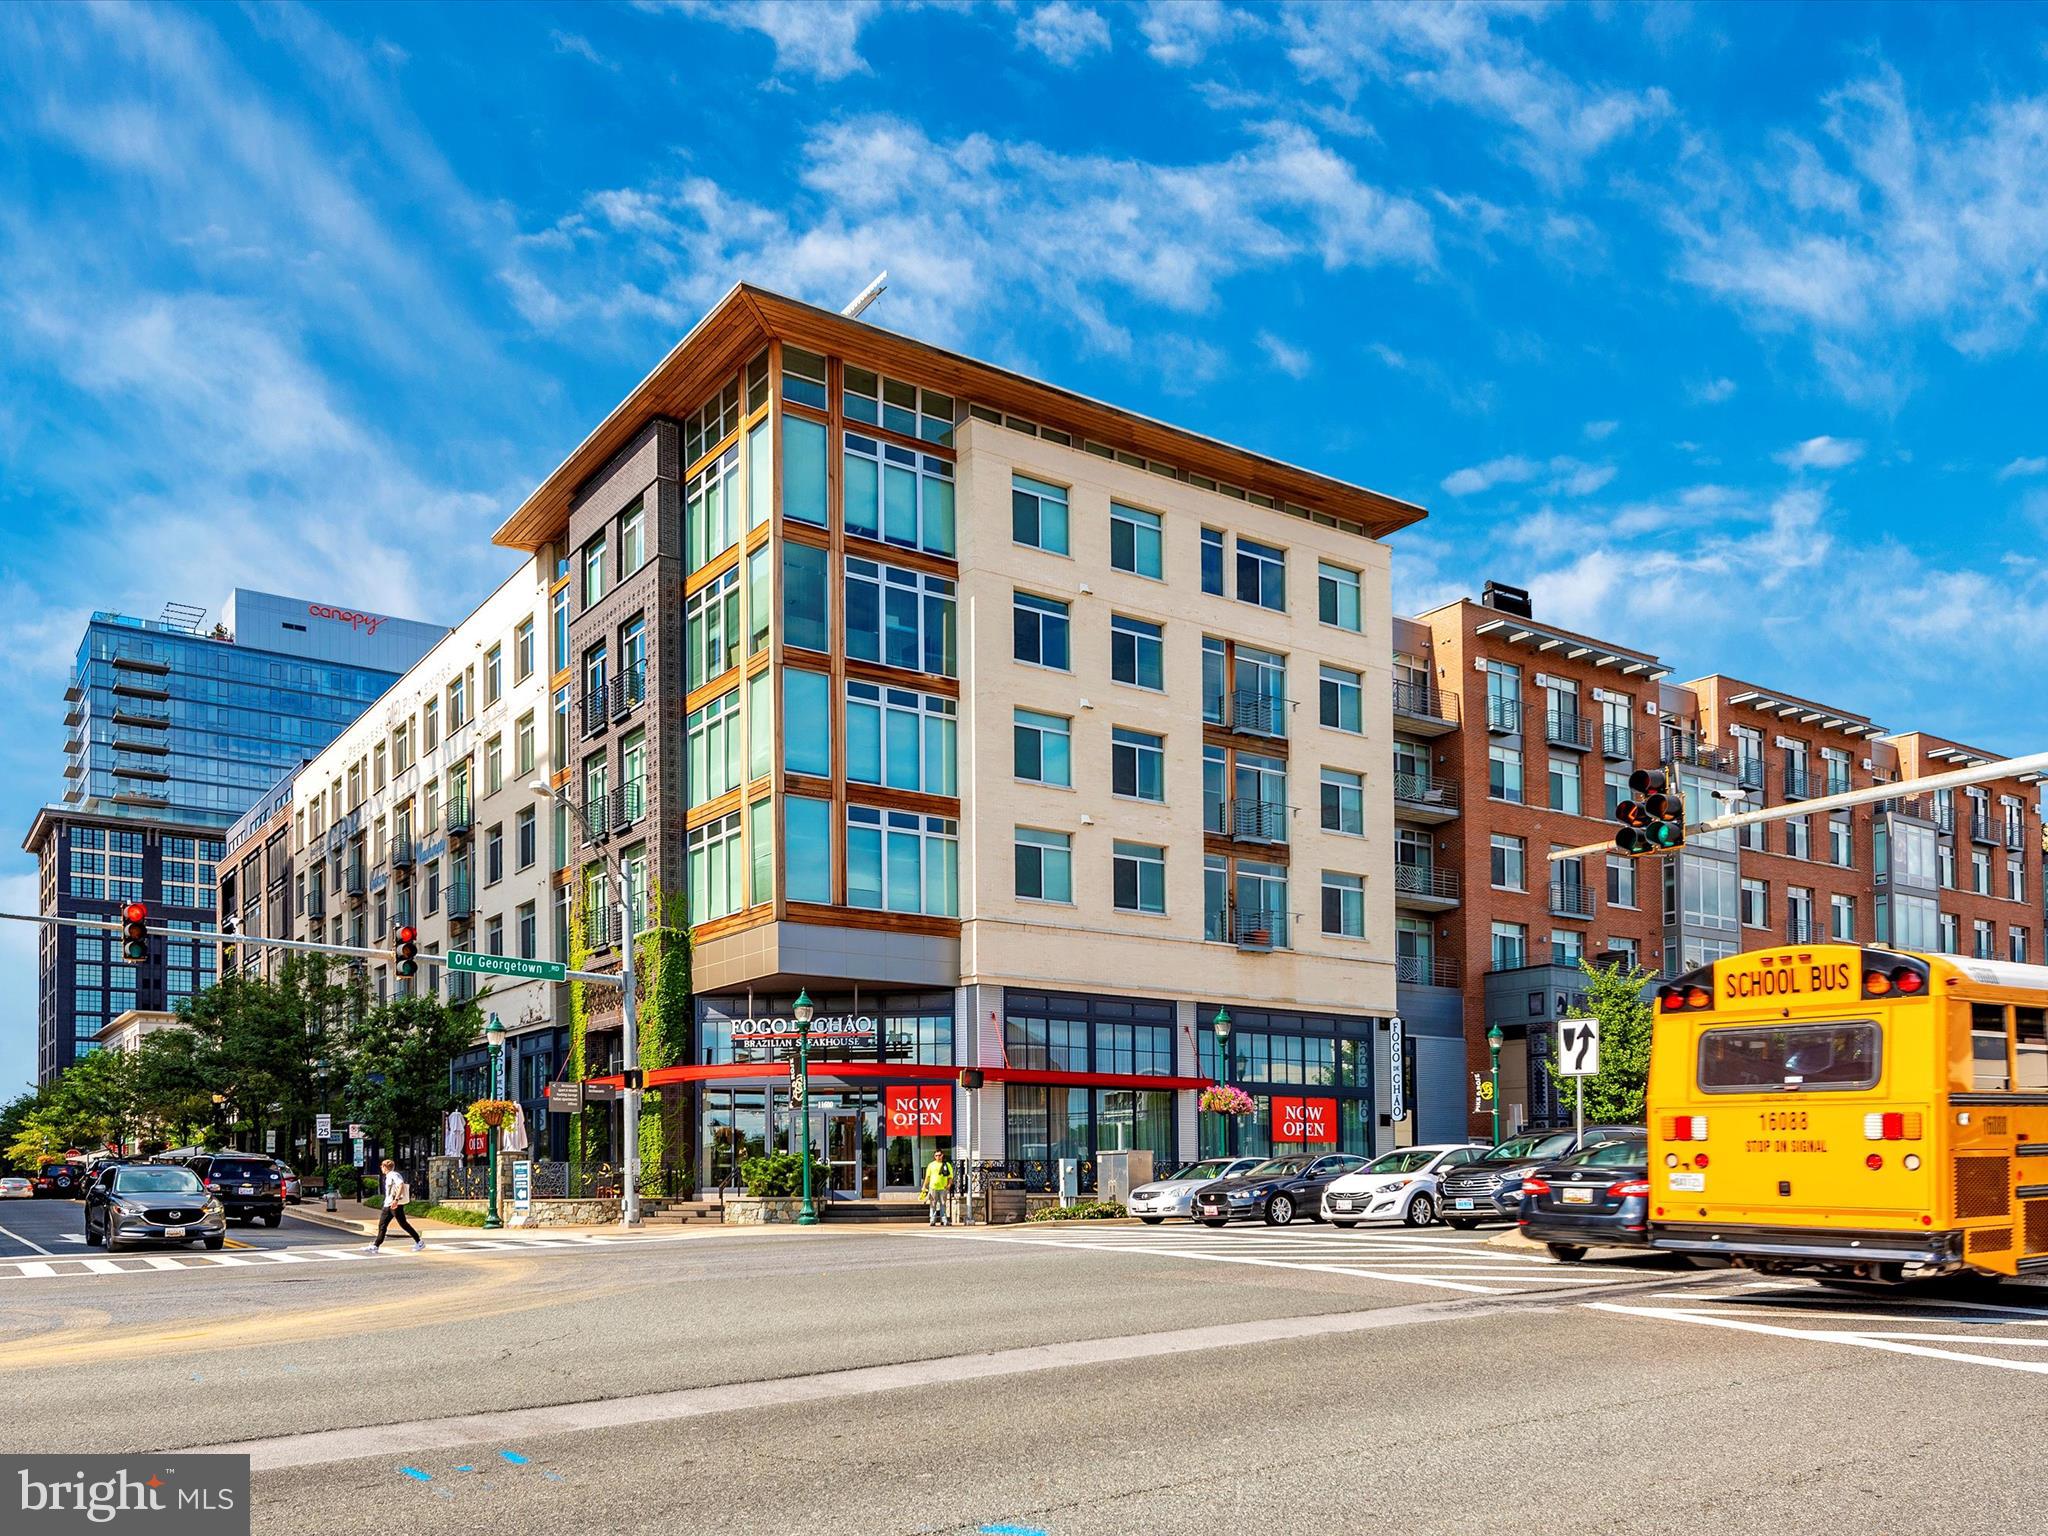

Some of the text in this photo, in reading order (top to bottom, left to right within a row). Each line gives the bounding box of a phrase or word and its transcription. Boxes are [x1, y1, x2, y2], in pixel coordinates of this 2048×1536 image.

[309, 605, 388, 635] canopy
[455, 954, 473, 966] Old
[479, 957, 543, 974] Georgetown
[1727, 964, 1849, 999] SCHOOL BUS
[731, 1018, 787, 1035] FOGO
[814, 1014, 872, 1033] CHÃO
[744, 1037, 860, 1048] BRAZILIAN SEAKHOUSE
[1392, 1022, 1401, 1063] FOGO
[896, 1098, 941, 1111] NOW
[893, 1112, 942, 1126] OPEN
[1285, 1106, 1323, 1120] NOW
[318, 1128, 330, 1137] 25
[1283, 1122, 1325, 1137] OPEN
[1745, 1140, 1827, 1153] STOP ON SIGNAL
